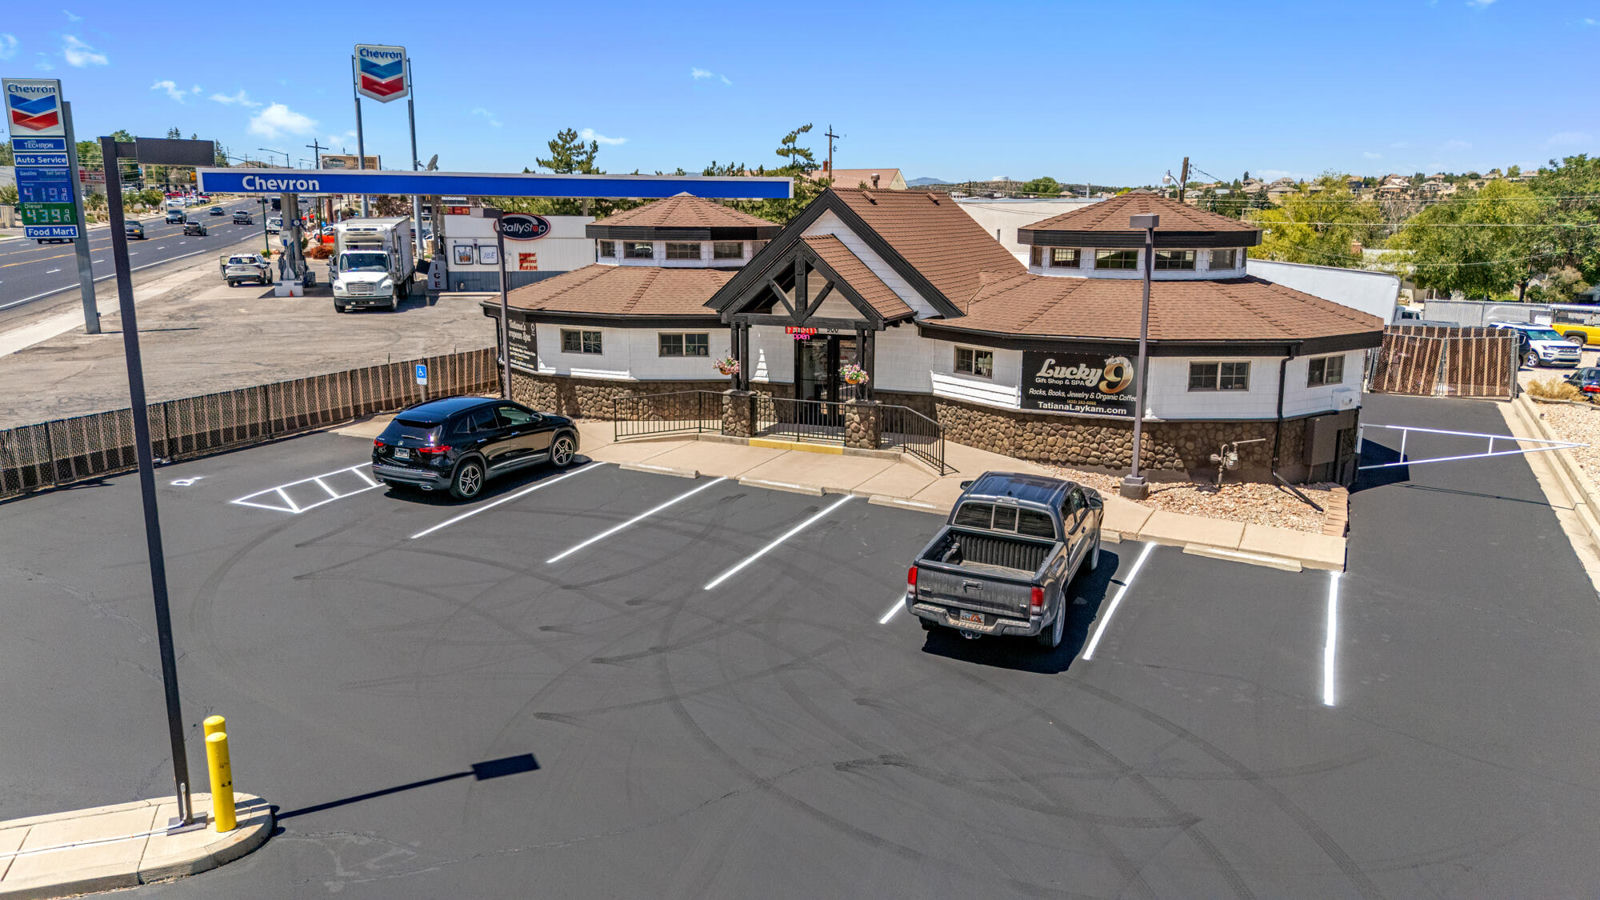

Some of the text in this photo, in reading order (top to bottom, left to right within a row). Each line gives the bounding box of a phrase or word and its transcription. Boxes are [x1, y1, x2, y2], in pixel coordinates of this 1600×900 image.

[360, 48, 402, 59] Chevron
[7, 83, 56, 94] Chevron
[37, 156, 67, 164] Service
[242, 175, 320, 191] Chevron
[52, 228, 74, 236] Mart
[1036, 356, 1134, 394] Lucky 9
[1047, 378, 1063, 386] Shop
[1067, 391, 1089, 400] Jewelry
[1095, 392, 1118, 401] Organic
[1037, 401, 1127, 415] TatianaLaykam.com
